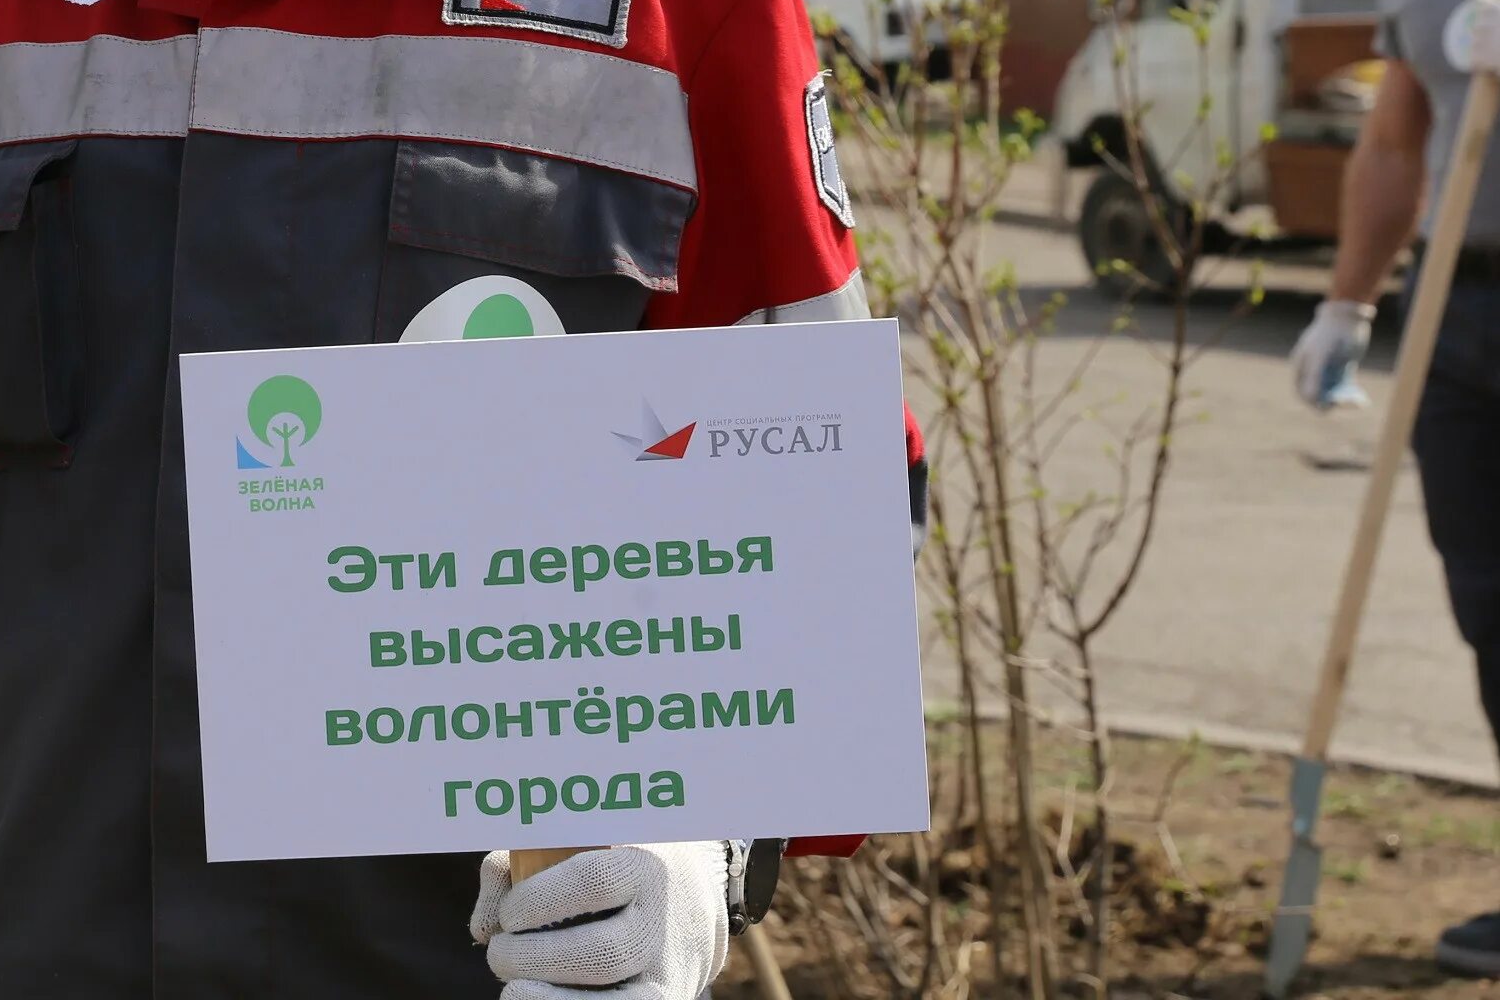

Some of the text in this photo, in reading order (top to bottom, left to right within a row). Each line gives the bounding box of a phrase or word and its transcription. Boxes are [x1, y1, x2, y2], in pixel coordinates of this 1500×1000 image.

[706, 413, 842, 427] ЦЕНТР СОЦИАЛЬНЫХ ПРОГРАММ
[707, 423, 843, 458] РУСАЛ
[238, 476, 324, 494] ЗЕЛЁНАЯ
[250, 496, 315, 512] ВОЛНА
[327, 536, 774, 593] Эти деревья
[369, 614, 742, 668] высажены
[325, 686, 795, 746] волонтёрами
[444, 770, 685, 825] города
